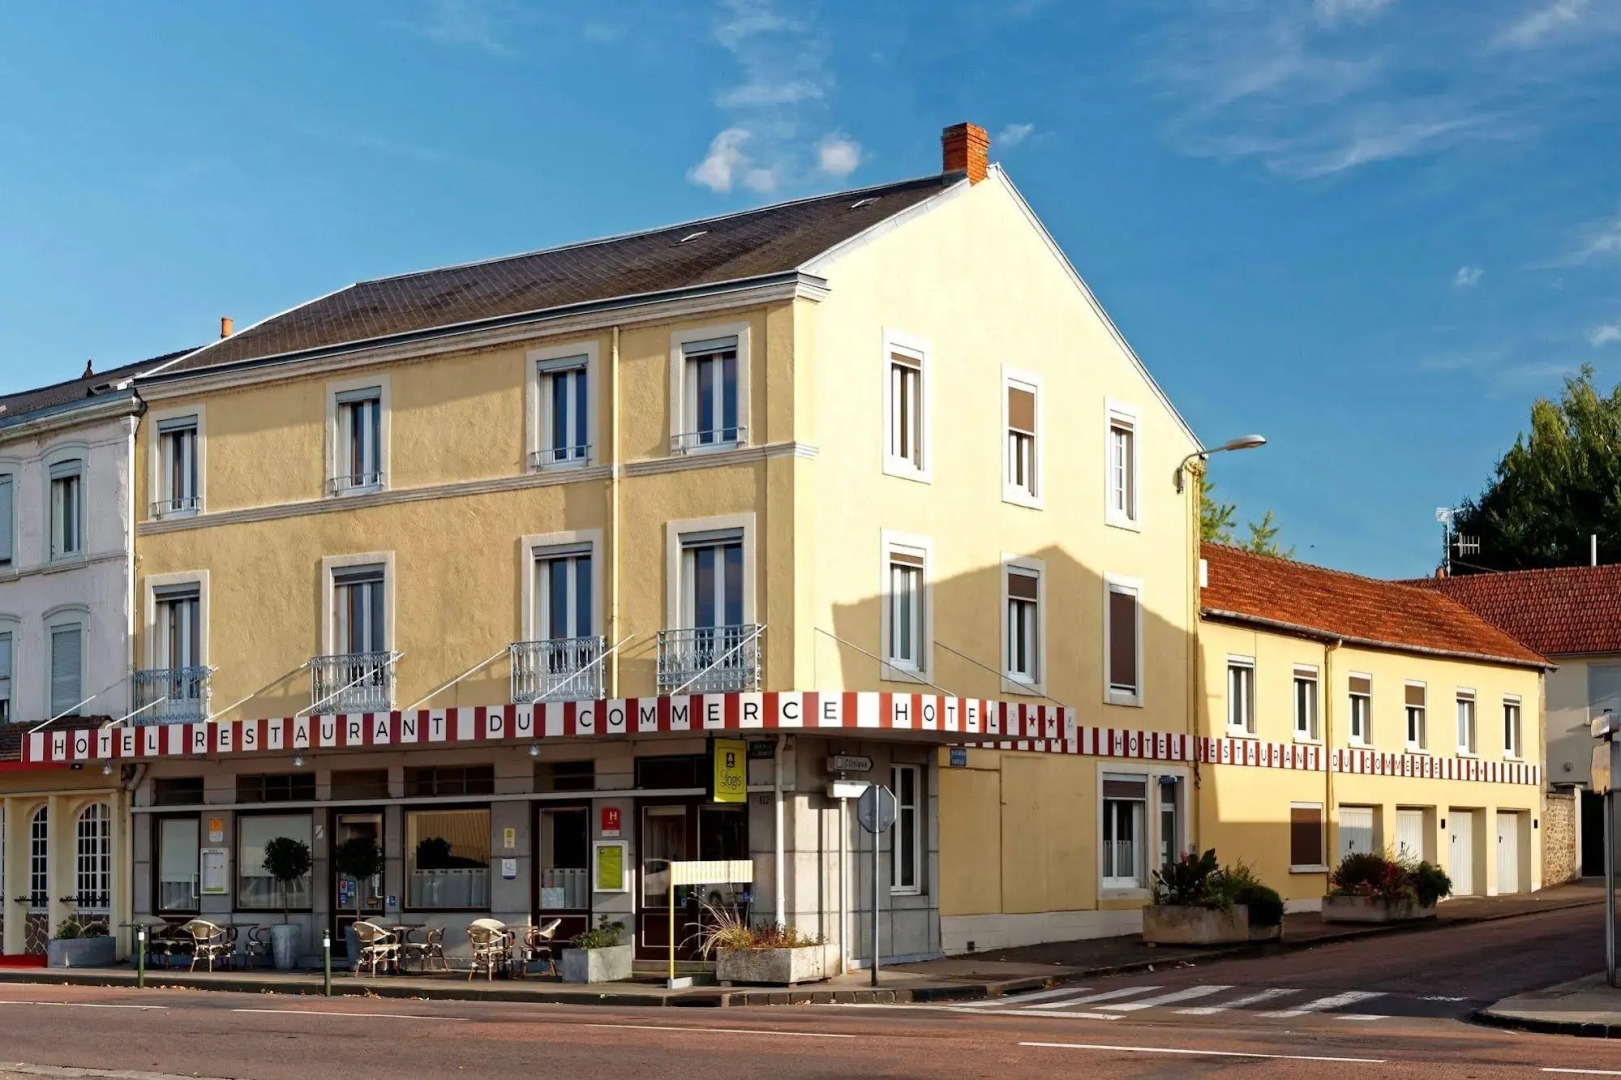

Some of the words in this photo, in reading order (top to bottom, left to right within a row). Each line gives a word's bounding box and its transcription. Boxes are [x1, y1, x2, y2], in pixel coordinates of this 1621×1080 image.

[54, 734, 156, 755] HOTEL
[195, 717, 443, 747] RESTAURANT
[490, 713, 530, 733] DU
[579, 701, 837, 728] COMMERCE
[895, 702, 997, 728] HOTEL
[1115, 736, 1179, 755] HOTEL
[1333, 754, 1349, 768] DU
[1365, 757, 1439, 774] COMMERCE
[609, 811, 618, 821] H
